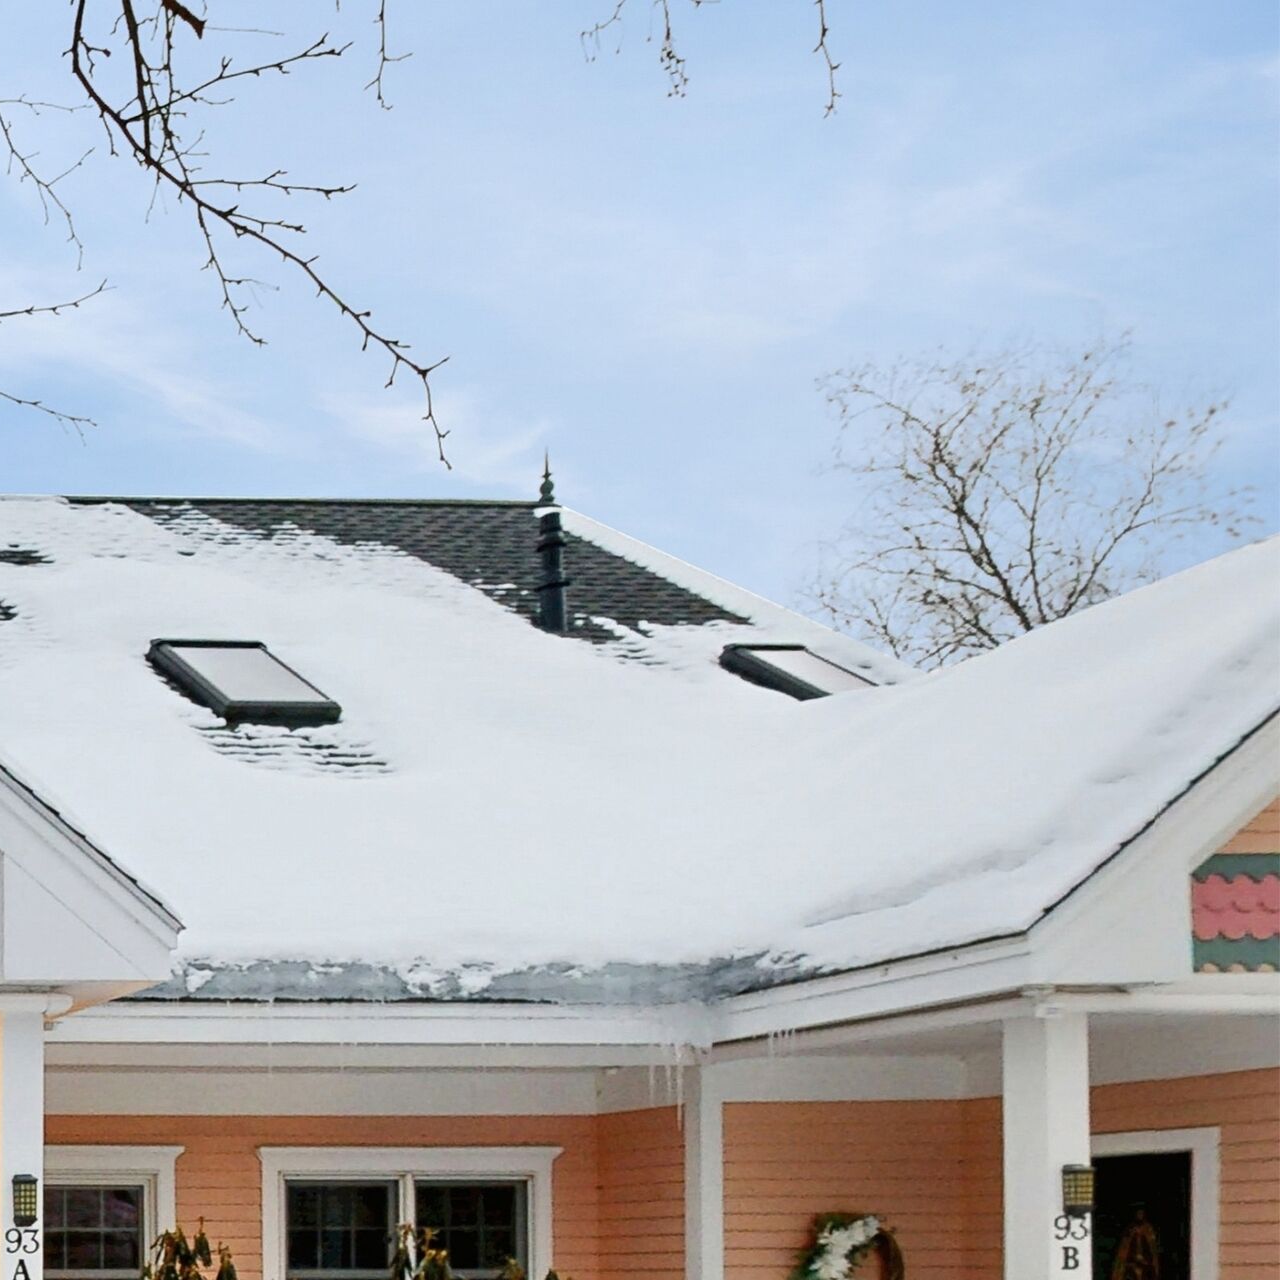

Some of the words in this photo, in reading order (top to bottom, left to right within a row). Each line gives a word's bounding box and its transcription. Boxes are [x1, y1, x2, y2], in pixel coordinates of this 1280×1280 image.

[1054, 1214, 1088, 1240] 93
[5, 1228, 40, 1254] 93
[1061, 1246, 1080, 1270] B
